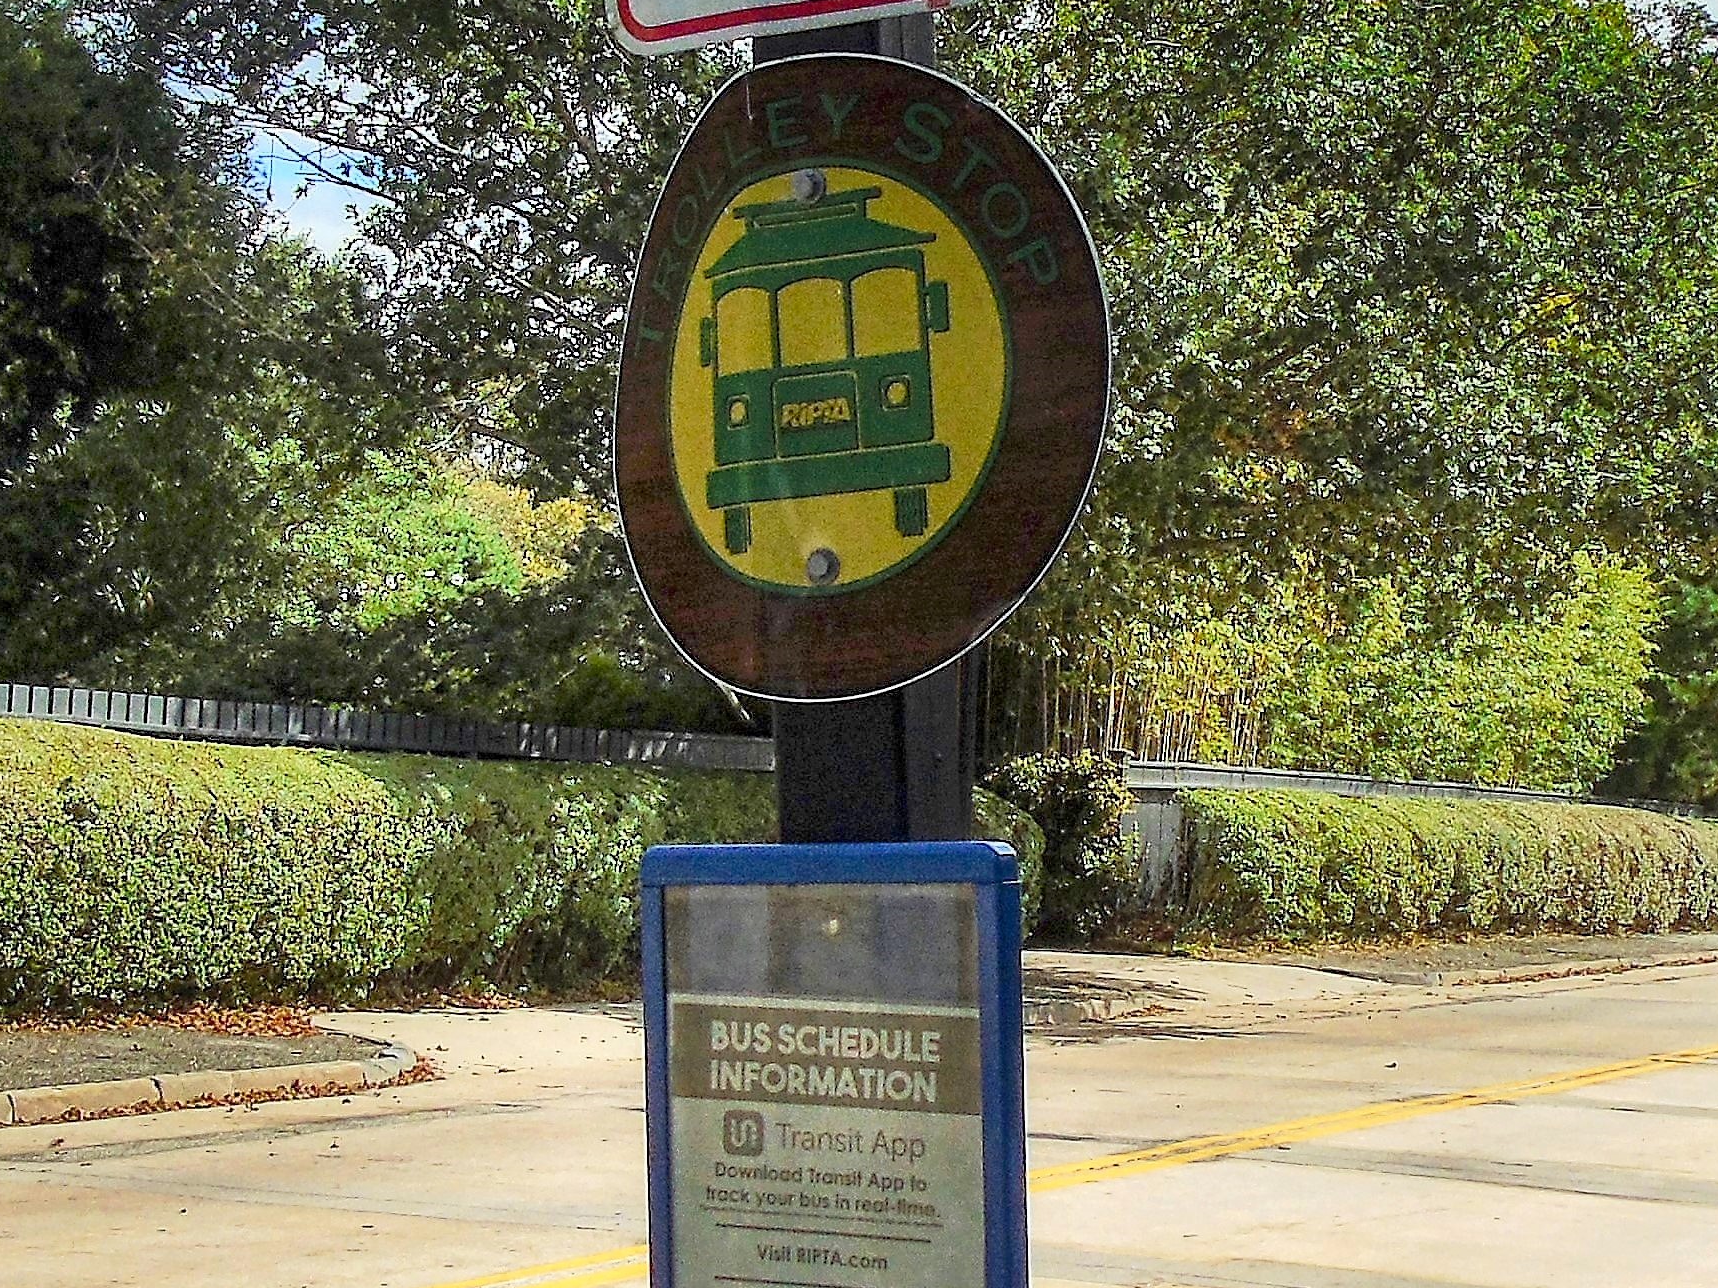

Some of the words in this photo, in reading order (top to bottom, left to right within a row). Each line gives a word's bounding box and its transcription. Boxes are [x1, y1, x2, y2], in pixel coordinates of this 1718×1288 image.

[634, 88, 864, 357] TROLLEY
[894, 99, 1062, 291] STOP
[710, 1019, 773, 1053] BUS
[777, 1022, 941, 1062] SCHEDULE
[710, 1059, 937, 1103] INFORMATION
[775, 1122, 864, 1154] Transit
[871, 1128, 927, 1164] App
[705, 1184, 750, 1204] track
[755, 1191, 796, 1208] your
[799, 1191, 829, 1210] bus
[835, 1193, 851, 1210] in
[714, 1161, 803, 1183] Download
[809, 1167, 862, 1187] Transit
[868, 1172, 905, 1192] App
[910, 1174, 929, 1192] to
[756, 1243, 791, 1263] Visit
[796, 1247, 889, 1270] RIPTA.com
